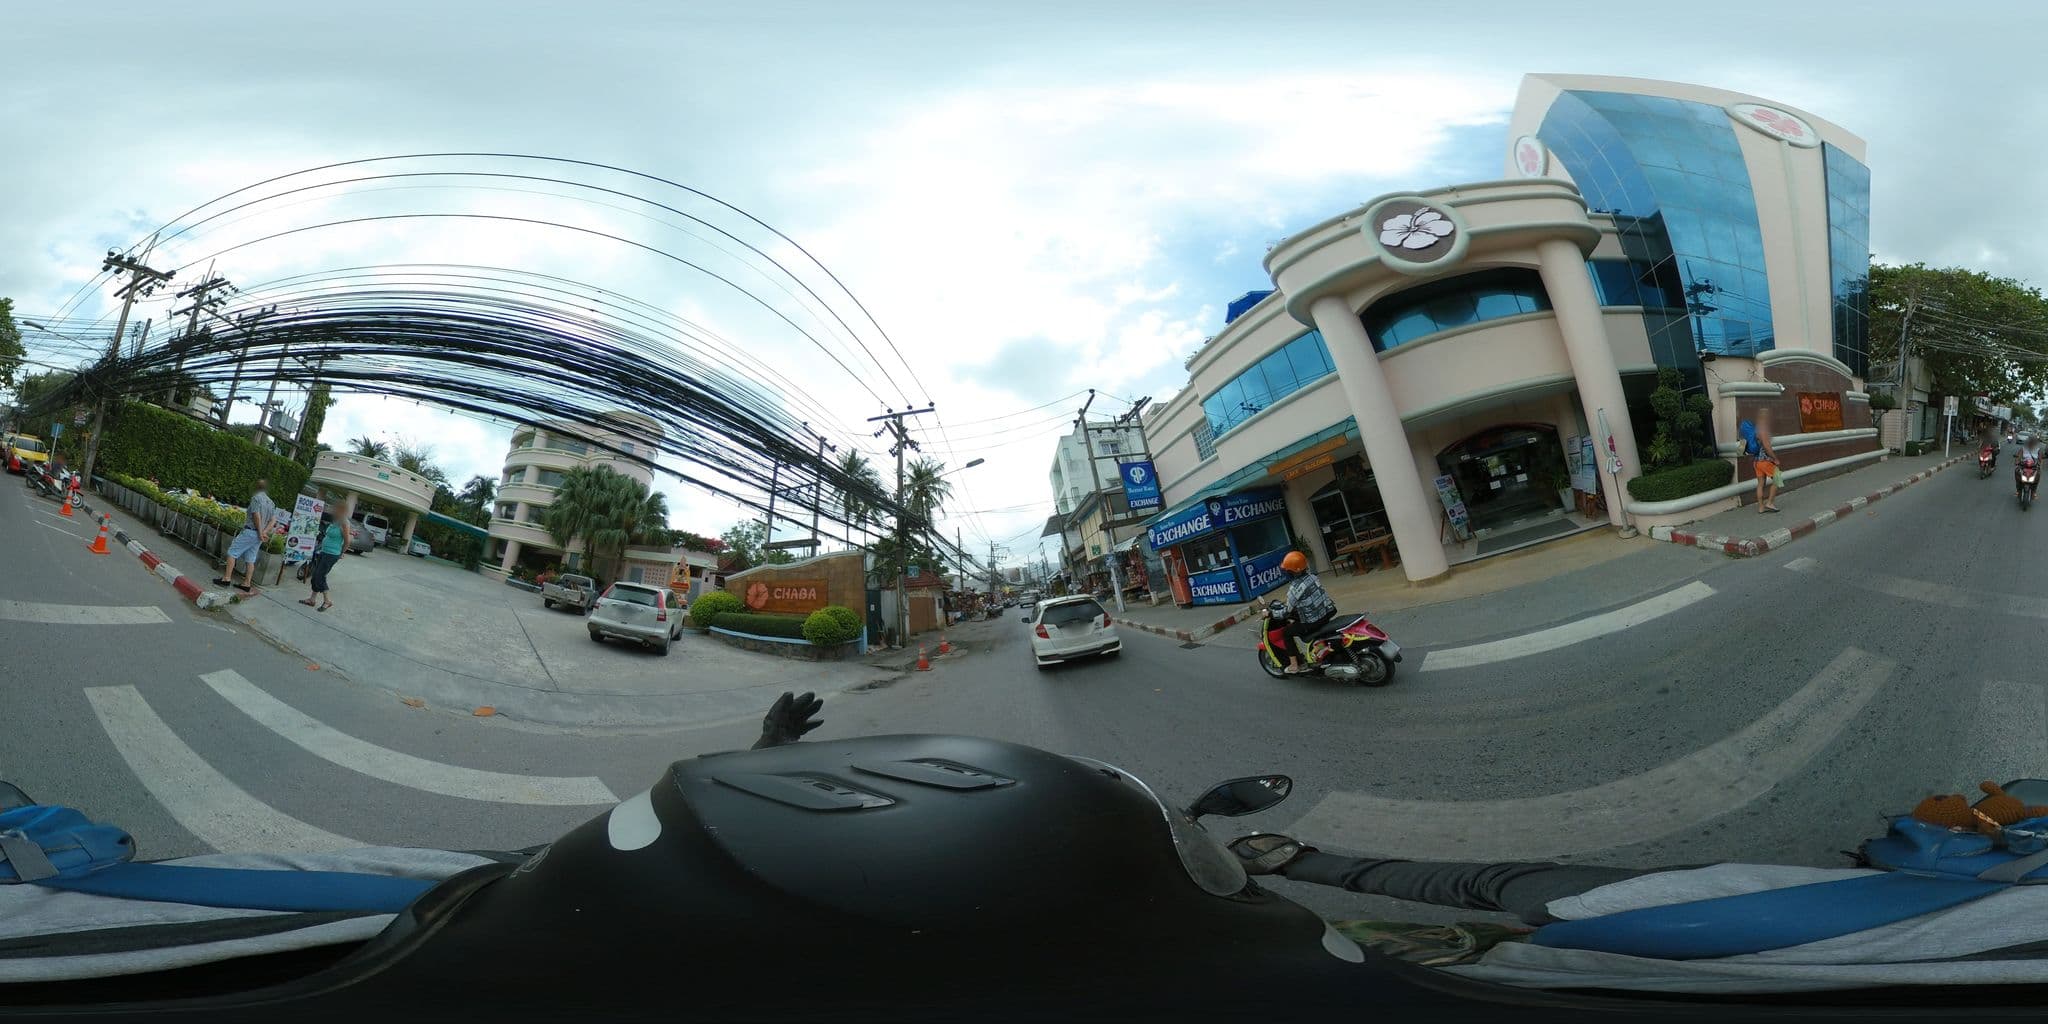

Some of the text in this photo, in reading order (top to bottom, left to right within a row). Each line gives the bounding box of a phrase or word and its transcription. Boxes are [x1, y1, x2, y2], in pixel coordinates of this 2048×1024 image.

[1130, 496, 1159, 508] EXCHANGE
[1224, 498, 1286, 522] EXCHANGE
[1157, 513, 1211, 546] EXCHANGE
[1250, 565, 1282, 590] EXCHA
[774, 588, 816, 600] CHABA
[1191, 581, 1237, 598] EXCHANGE
